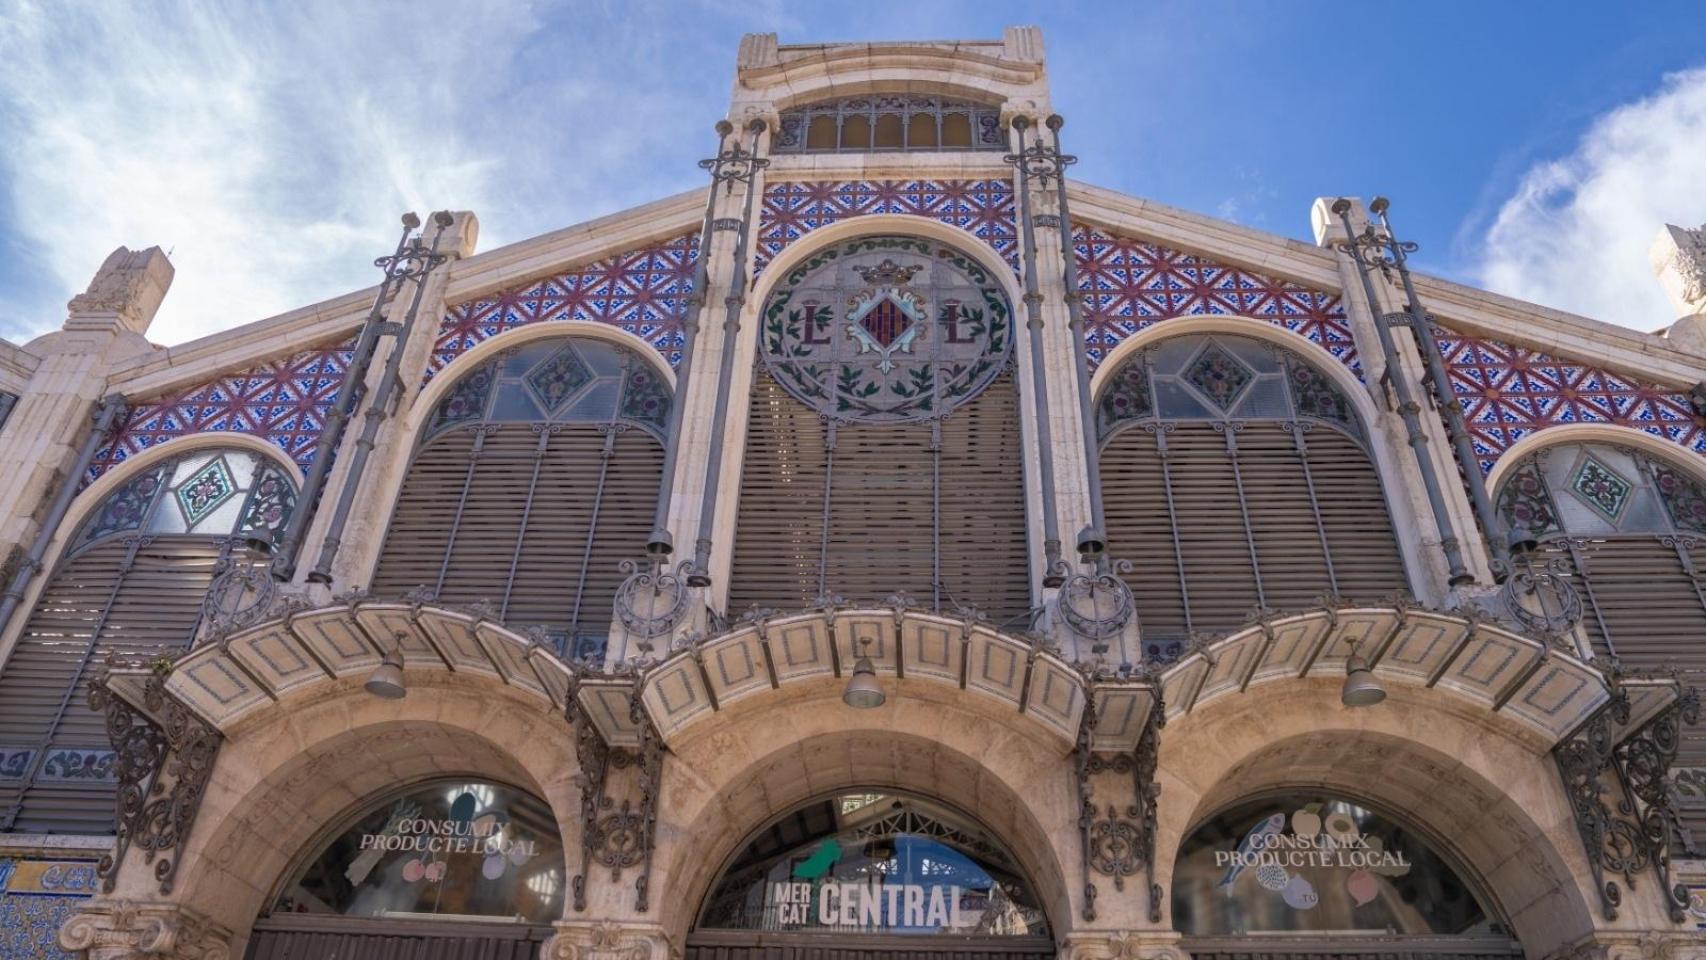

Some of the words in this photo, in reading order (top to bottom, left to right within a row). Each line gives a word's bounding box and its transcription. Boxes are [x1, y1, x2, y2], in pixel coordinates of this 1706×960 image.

[360, 834, 467, 854] PRODUCTE
[471, 839, 540, 857] LOCAL
[1249, 832, 1371, 850] CONSUMIX
[1215, 850, 1334, 867] PRODUCTE
[1338, 850, 1411, 867] LOCAL
[775, 882, 811, 903] MER
[779, 903, 810, 925] CAT
[819, 883, 969, 927] CENTRAL
